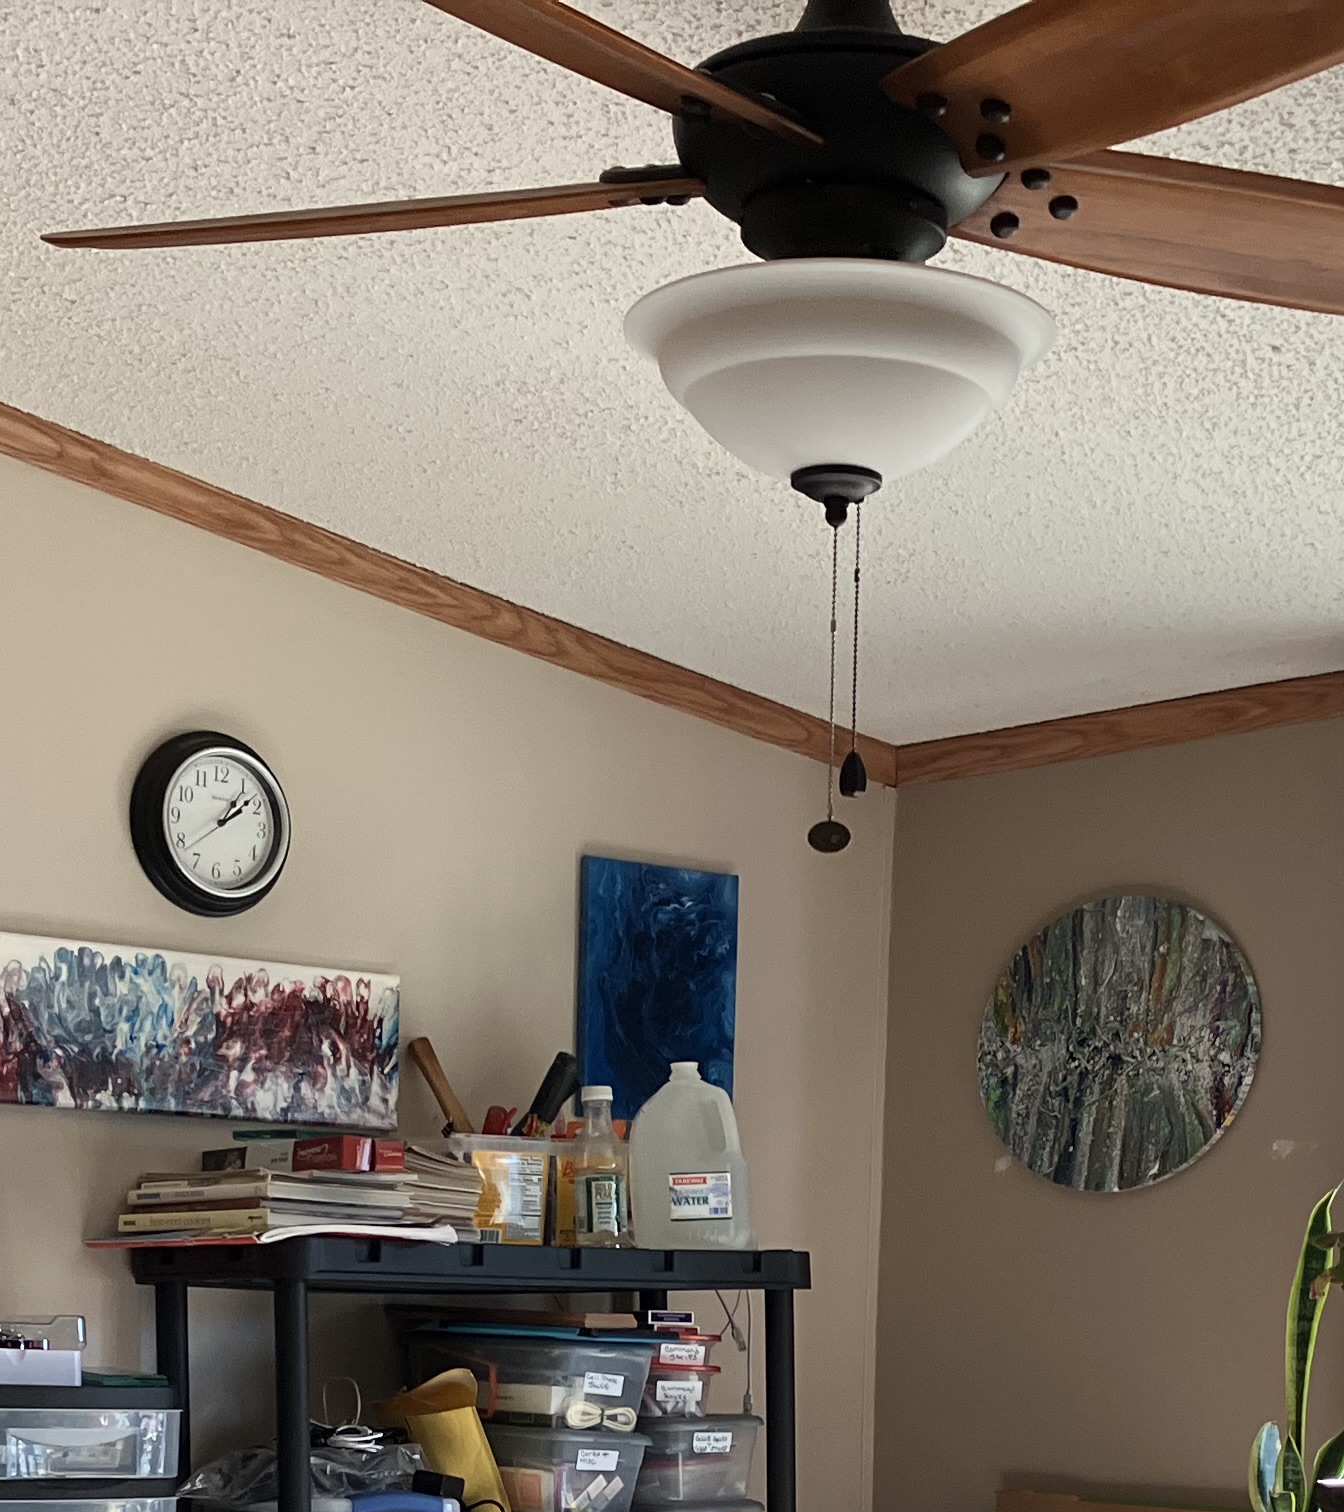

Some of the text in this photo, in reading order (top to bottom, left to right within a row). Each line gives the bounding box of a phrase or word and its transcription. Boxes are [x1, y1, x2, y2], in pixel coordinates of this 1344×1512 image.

[195, 769, 207, 788] 11
[213, 765, 230, 784] 12
[179, 785, 194, 803] 10
[240, 777, 246, 795] 1
[170, 806, 181, 824] 9
[252, 799, 262, 815] 2
[256, 822, 266, 839] 3
[175, 832, 186, 849] 8
[192, 852, 201, 870] 7
[248, 844, 257, 861] 4
[211, 861, 221, 879] 6
[232, 859, 242, 877] 5
[671, 1195, 709, 1206] WATER
